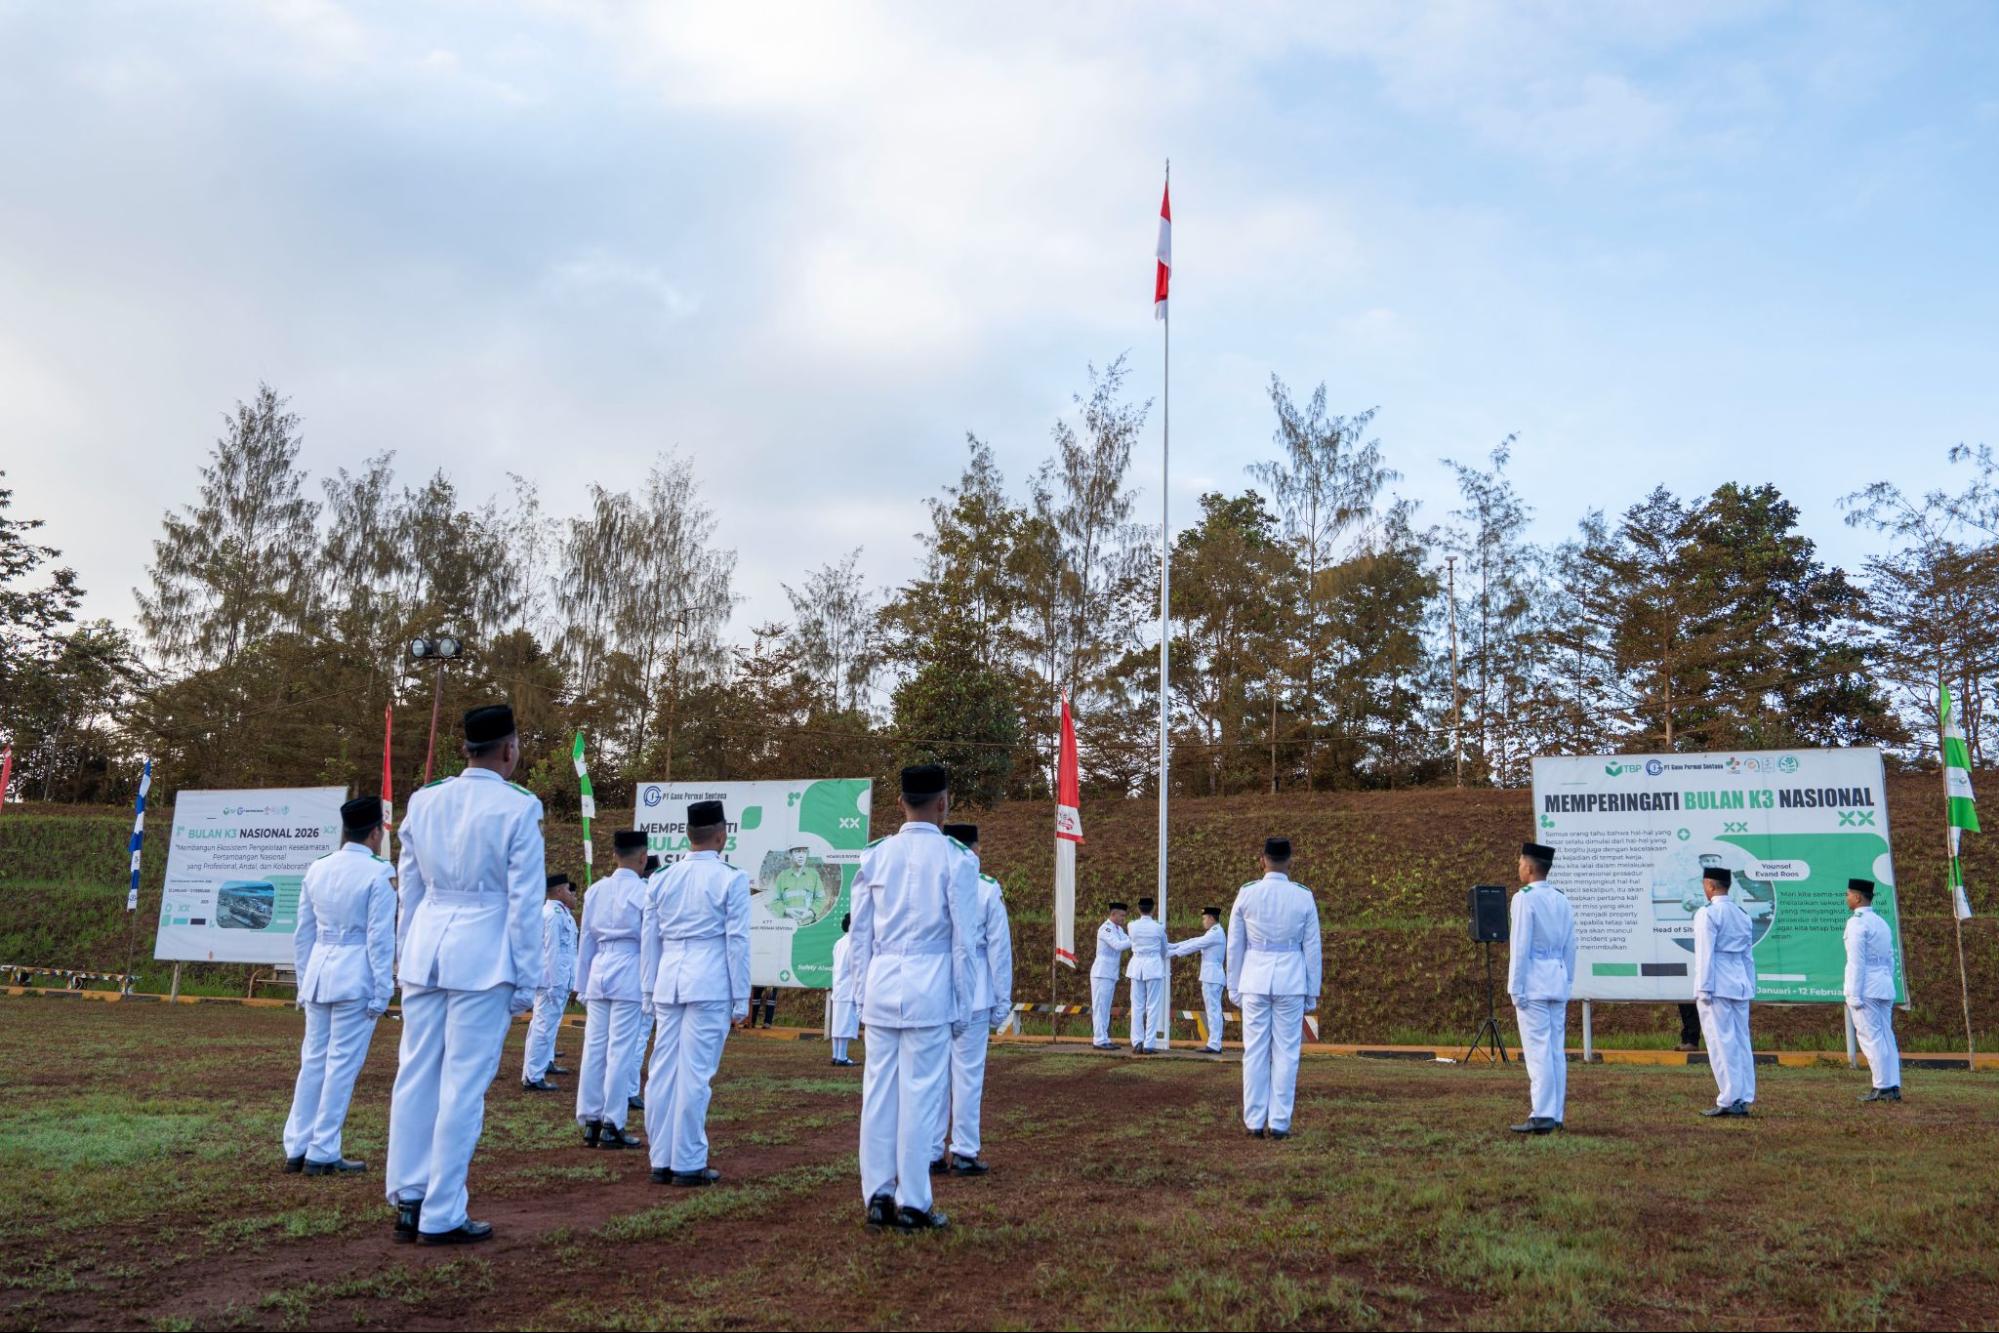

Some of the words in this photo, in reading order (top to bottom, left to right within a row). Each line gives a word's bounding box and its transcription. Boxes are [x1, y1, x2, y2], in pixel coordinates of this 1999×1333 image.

[1623, 764, 1642, 773] TBP
[1544, 791, 1679, 813] MEMPERINGATI
[1684, 789, 1745, 810] BULAN
[1748, 789, 1774, 809] K3
[1778, 787, 1874, 808] NASIONAL
[640, 822, 738, 833] MEMPETI
[188, 828, 223, 838] BULAN
[224, 828, 238, 838] K3
[239, 828, 292, 838] NASIONAL
[294, 828, 319, 838] 2026
[1757, 986, 1791, 994] Januari
[1798, 987, 1808, 995] 12
[1810, 988, 1844, 996] Februa
